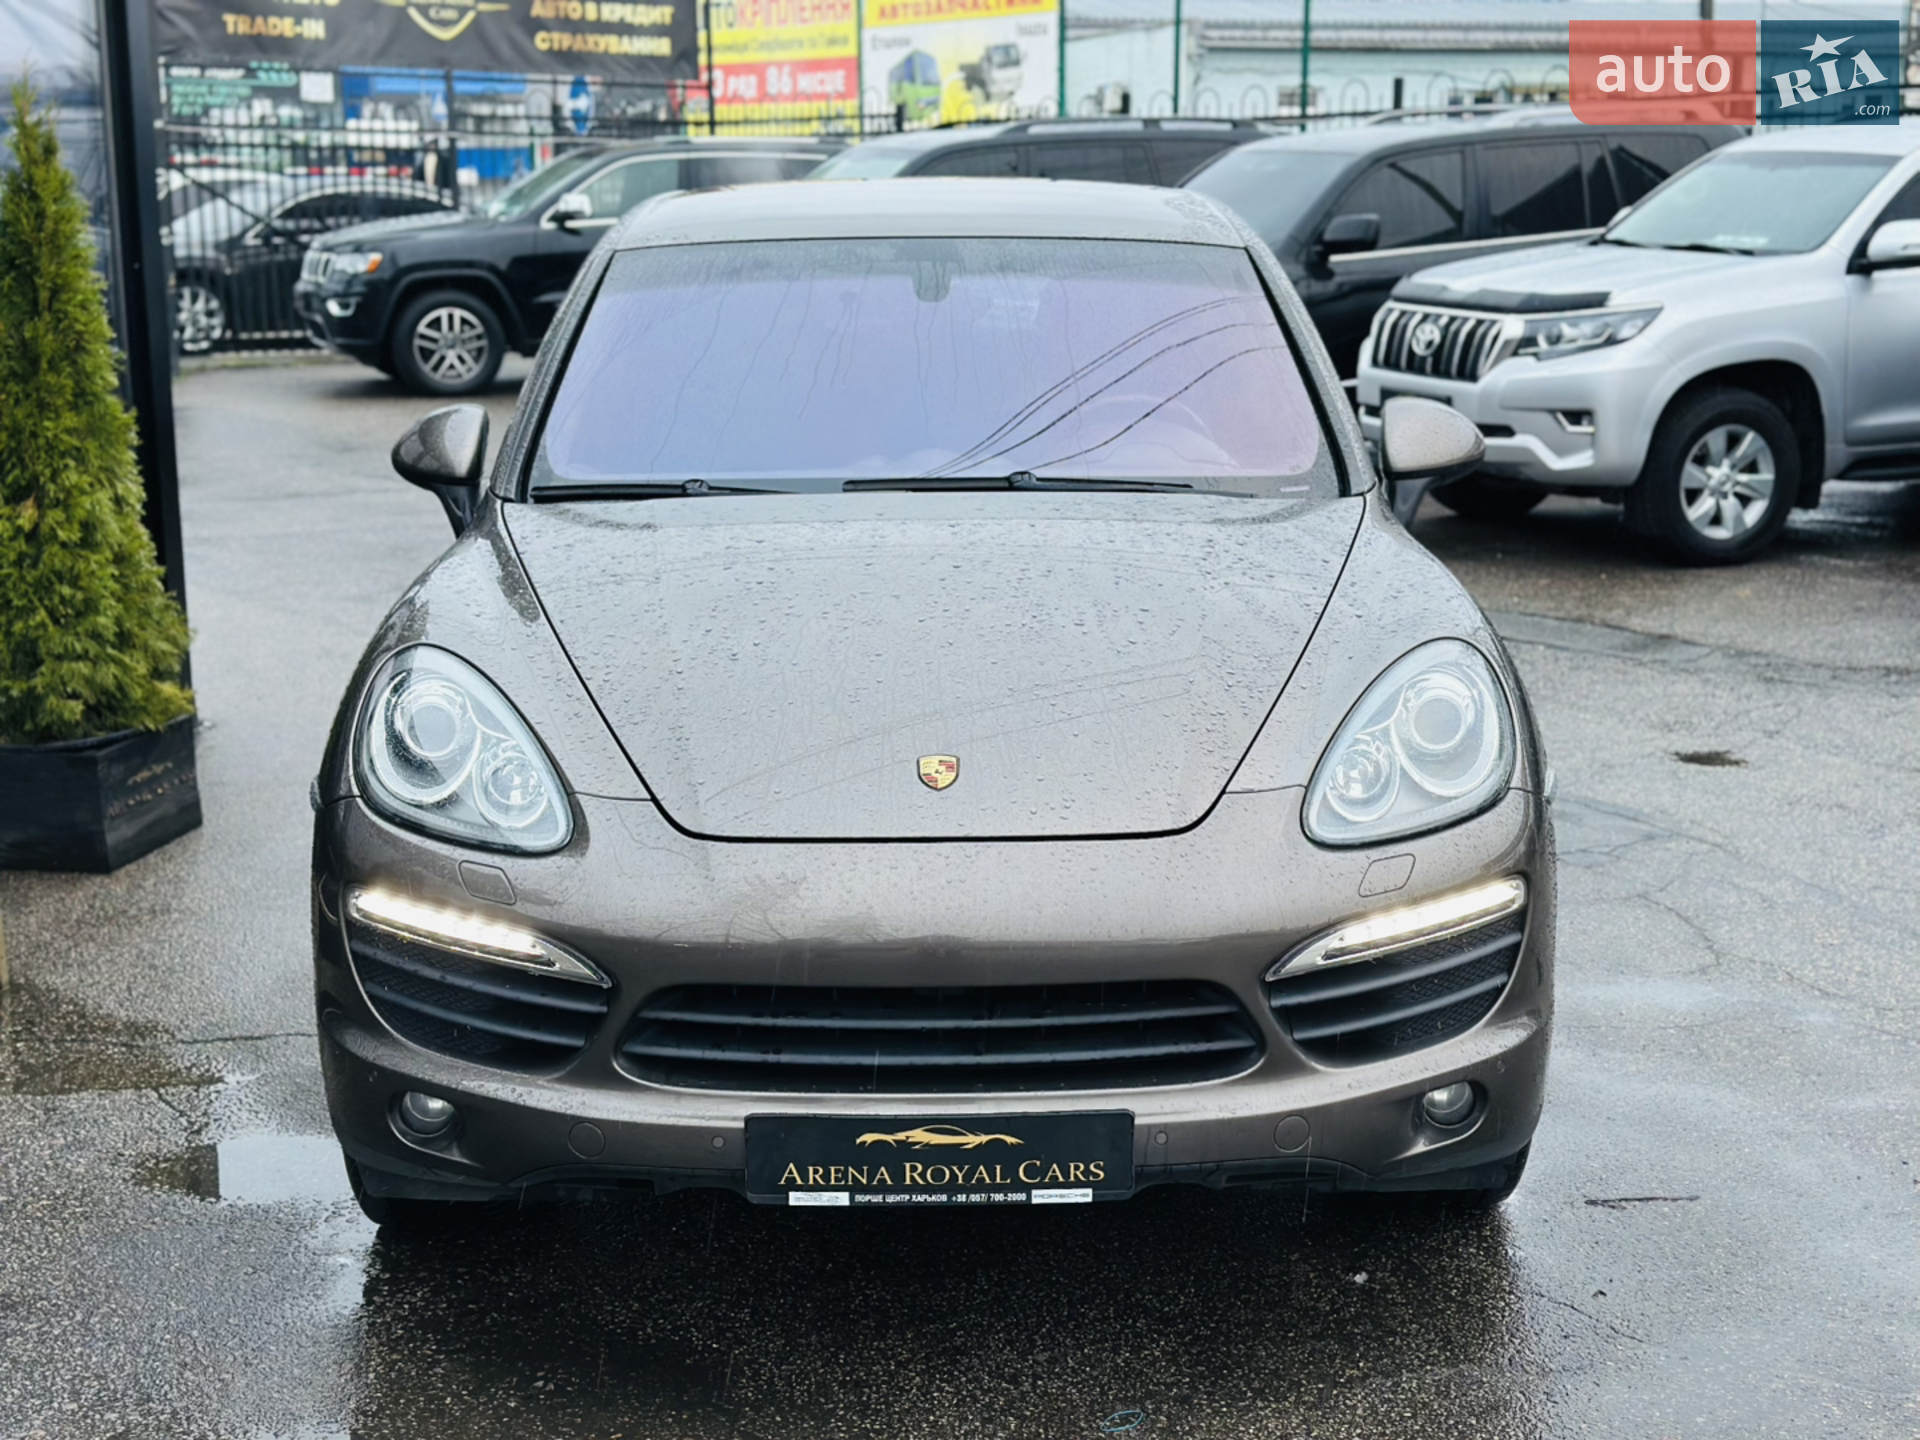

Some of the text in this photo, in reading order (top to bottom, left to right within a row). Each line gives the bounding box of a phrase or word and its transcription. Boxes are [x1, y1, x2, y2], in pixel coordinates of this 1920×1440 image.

[530, 0, 675, 26] АВТО В КРЕДИТ
[222, 13, 326, 40] TRADE-IN
[533, 30, 673, 57] СТРАХУВАННЯ
[777, 1160, 1106, 1185] ARENA ROYAL CARS
[854, 1194, 884, 1203] ПОРШЕ
[885, 1194, 910, 1203] ЦЕНТР
[911, 1194, 948, 1203] ХАРЬКОВ
